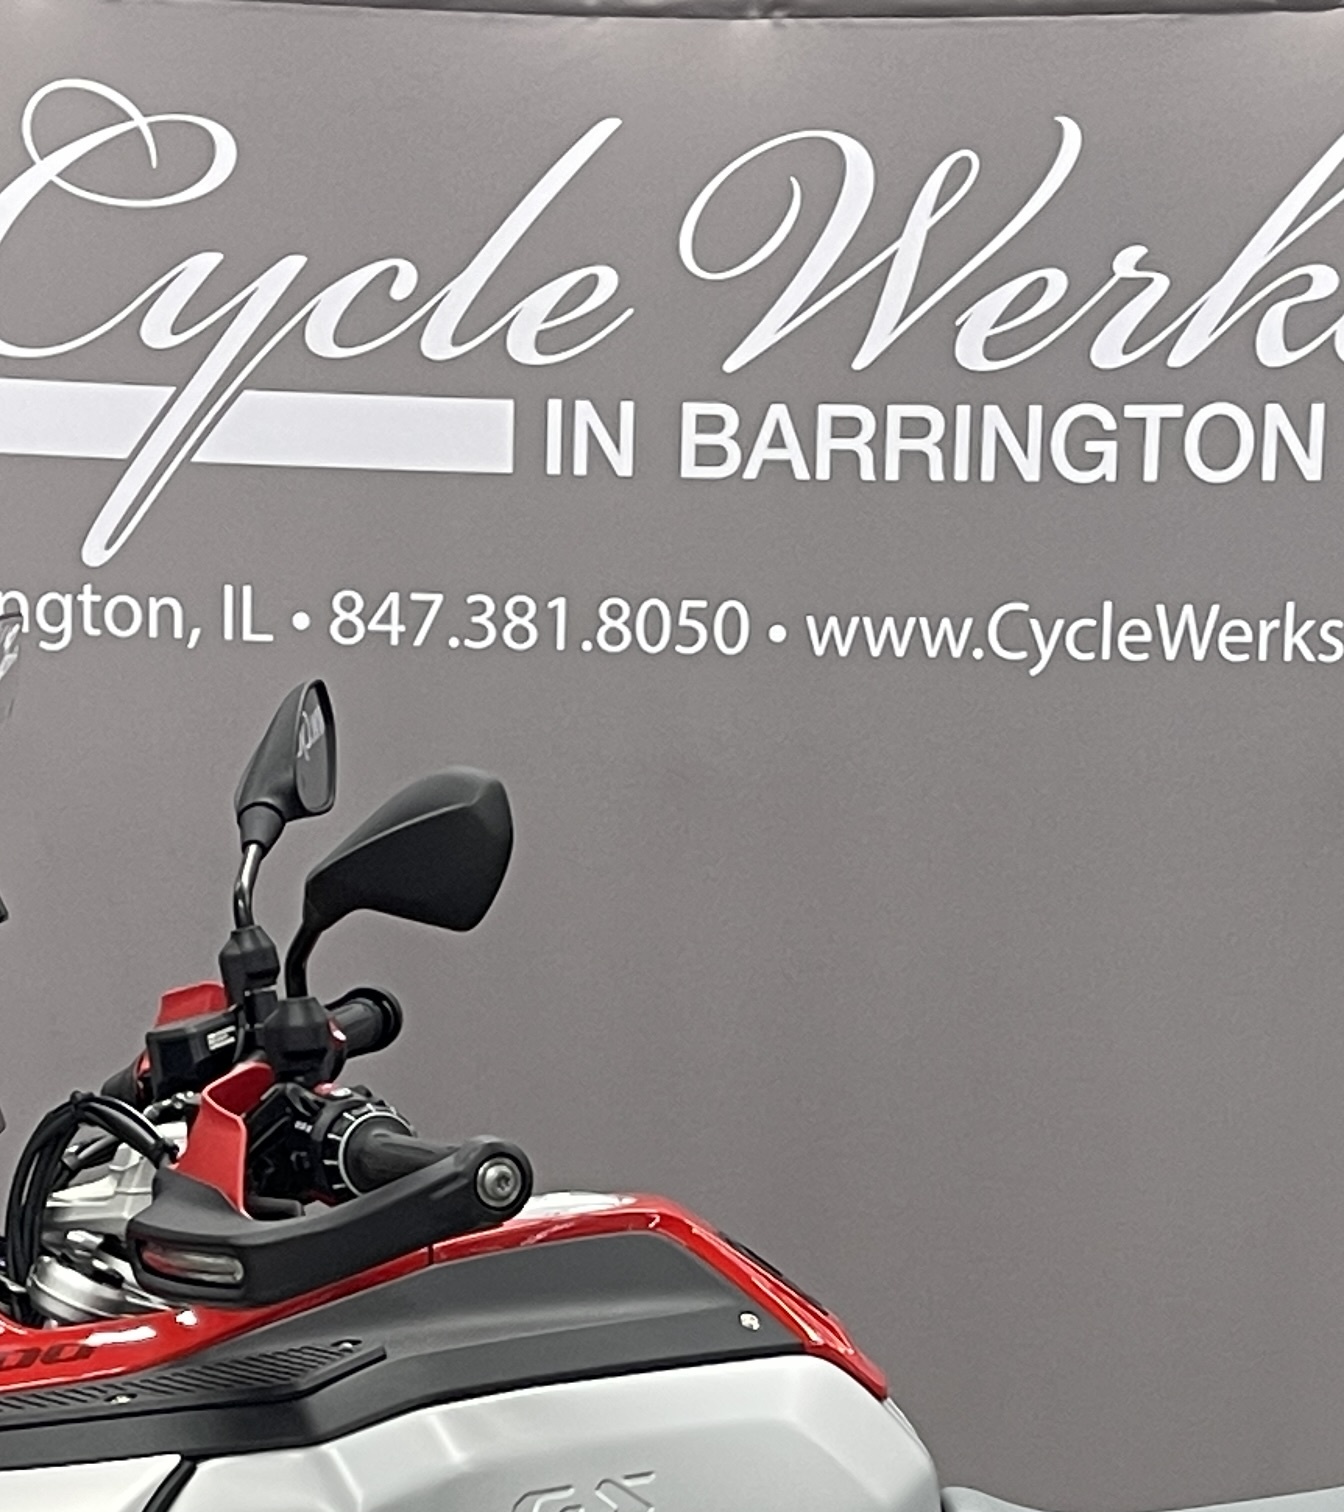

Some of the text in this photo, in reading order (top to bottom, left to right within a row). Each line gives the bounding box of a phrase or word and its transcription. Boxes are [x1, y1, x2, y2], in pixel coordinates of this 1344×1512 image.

[545, 398, 1326, 485] IN BARRINGTON
[223, 583, 274, 642] IL
[329, 589, 750, 656] 847.381.8050
